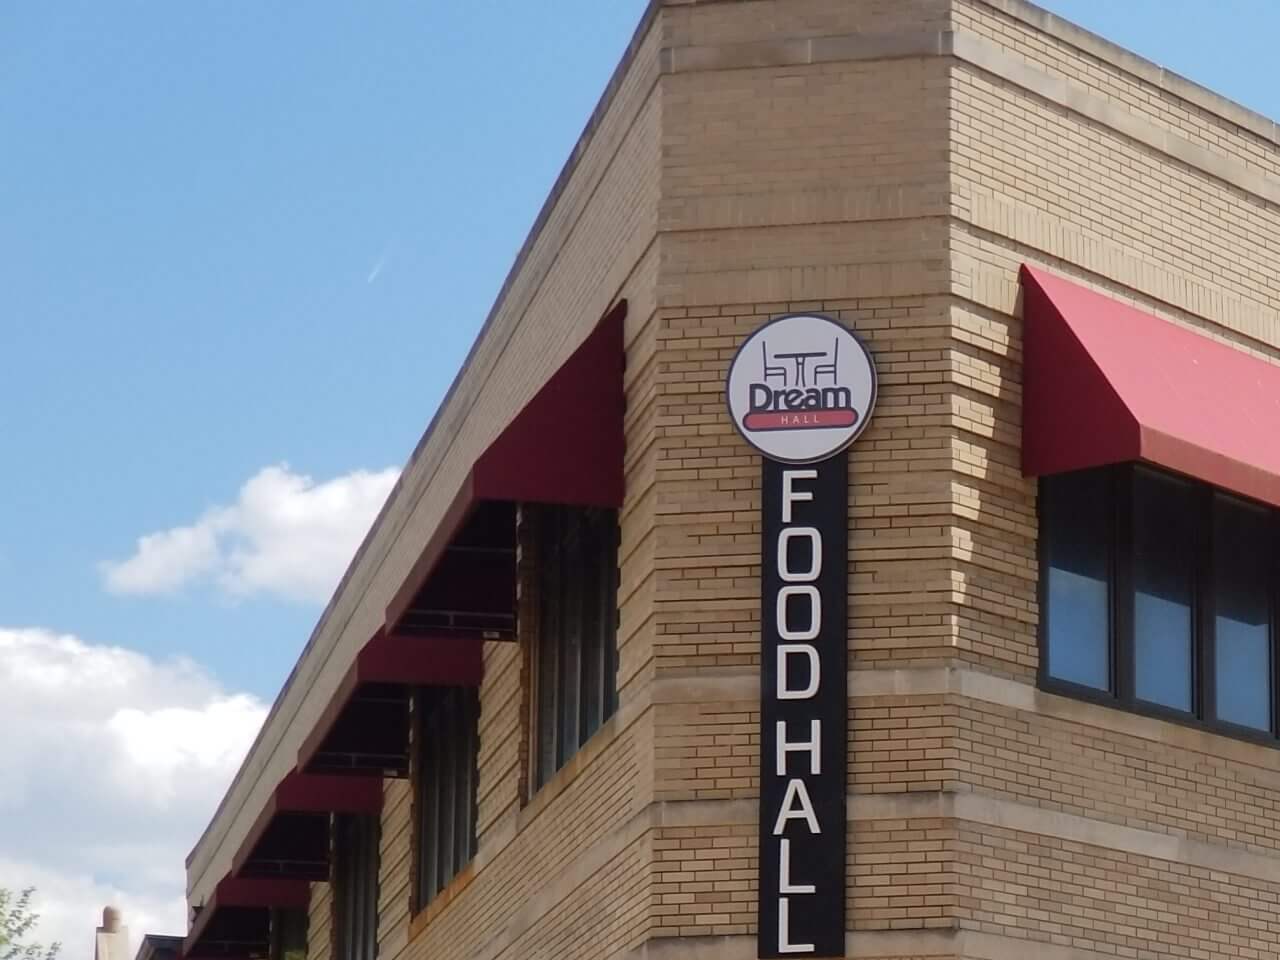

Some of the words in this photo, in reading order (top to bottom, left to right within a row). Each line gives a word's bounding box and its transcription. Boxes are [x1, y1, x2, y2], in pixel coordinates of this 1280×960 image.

[749, 384, 851, 411] Dream
[781, 414, 820, 425] HALL
[777, 470, 822, 699] FOOD
[773, 720, 822, 953] HALL
